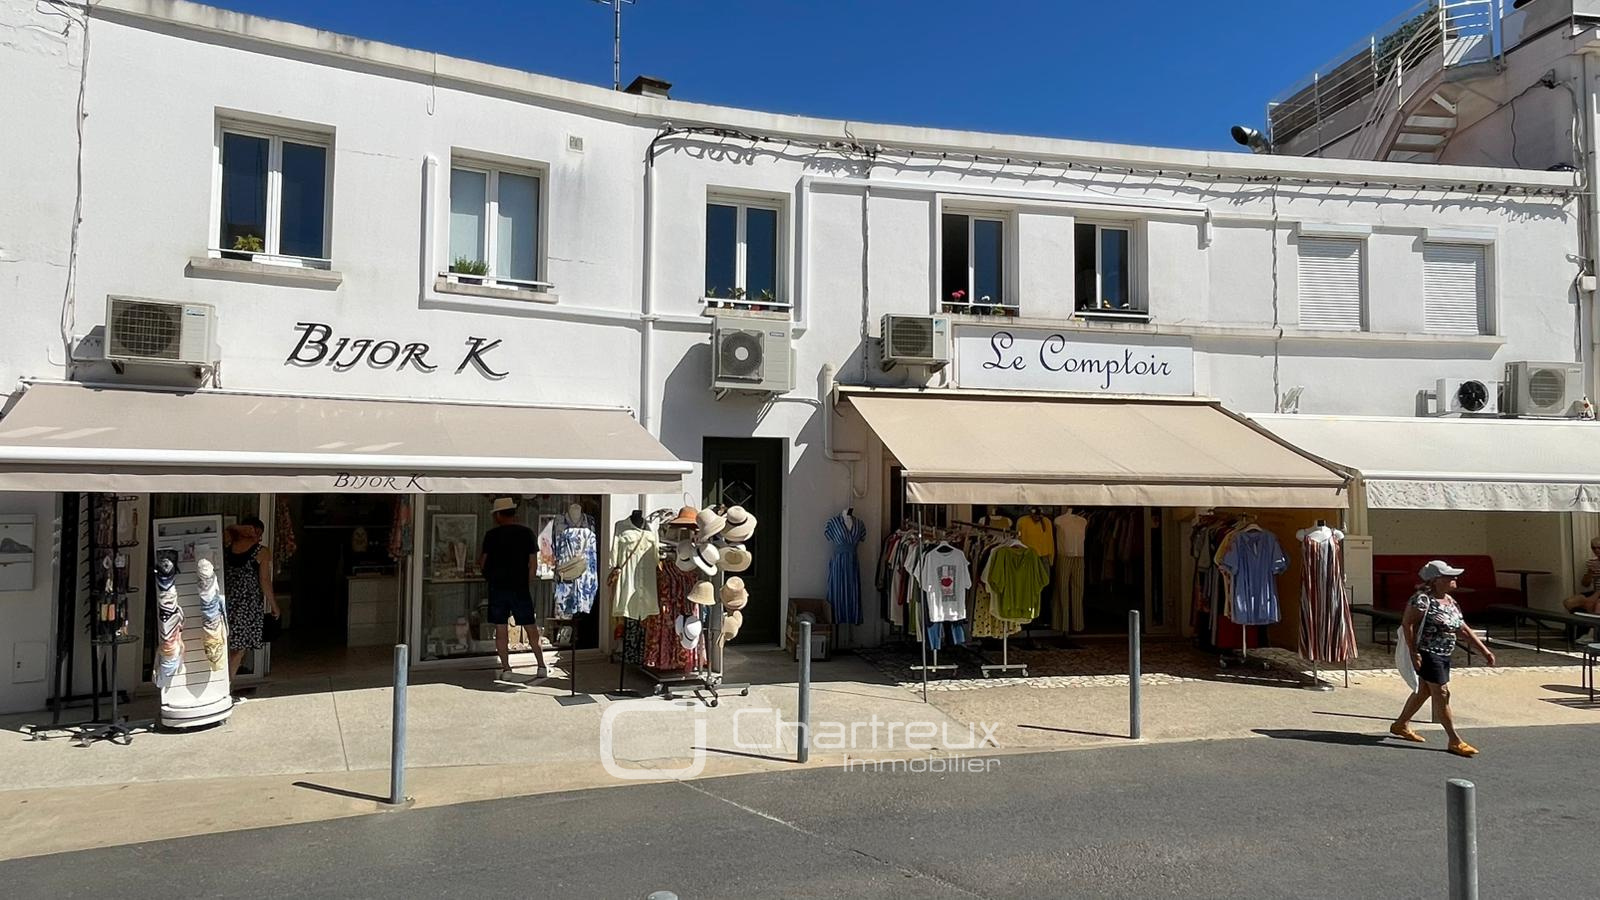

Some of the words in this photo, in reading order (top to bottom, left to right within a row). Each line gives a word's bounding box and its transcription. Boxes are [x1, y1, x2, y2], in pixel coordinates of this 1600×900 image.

[284, 322, 438, 373] BIJOR
[454, 335, 510, 381] K
[982, 331, 1026, 370] Le
[1039, 334, 1172, 390] Comptoir
[333, 472, 402, 491] BIJOR
[406, 472, 433, 492] K
